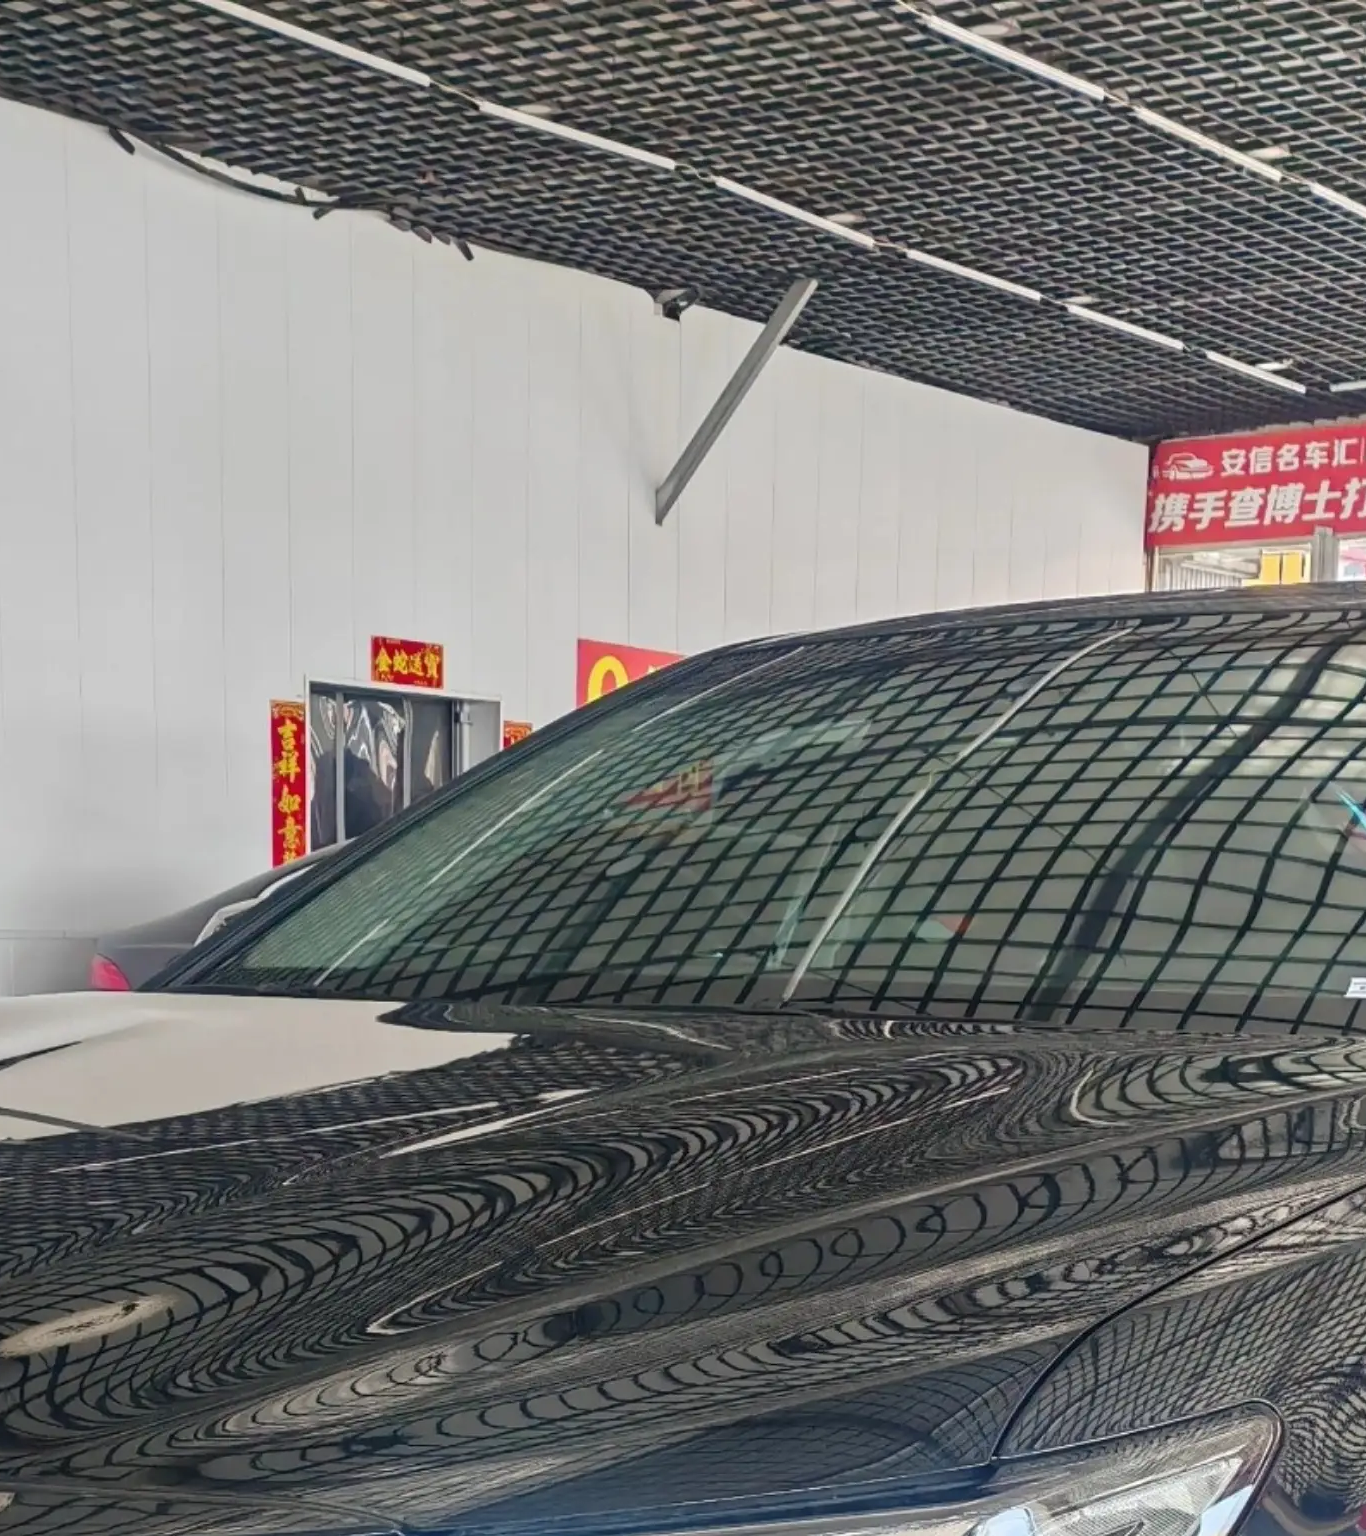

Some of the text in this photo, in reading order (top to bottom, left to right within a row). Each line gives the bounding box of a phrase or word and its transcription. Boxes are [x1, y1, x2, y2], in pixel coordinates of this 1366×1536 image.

[1220, 437, 1359, 477] 安信名车汇
